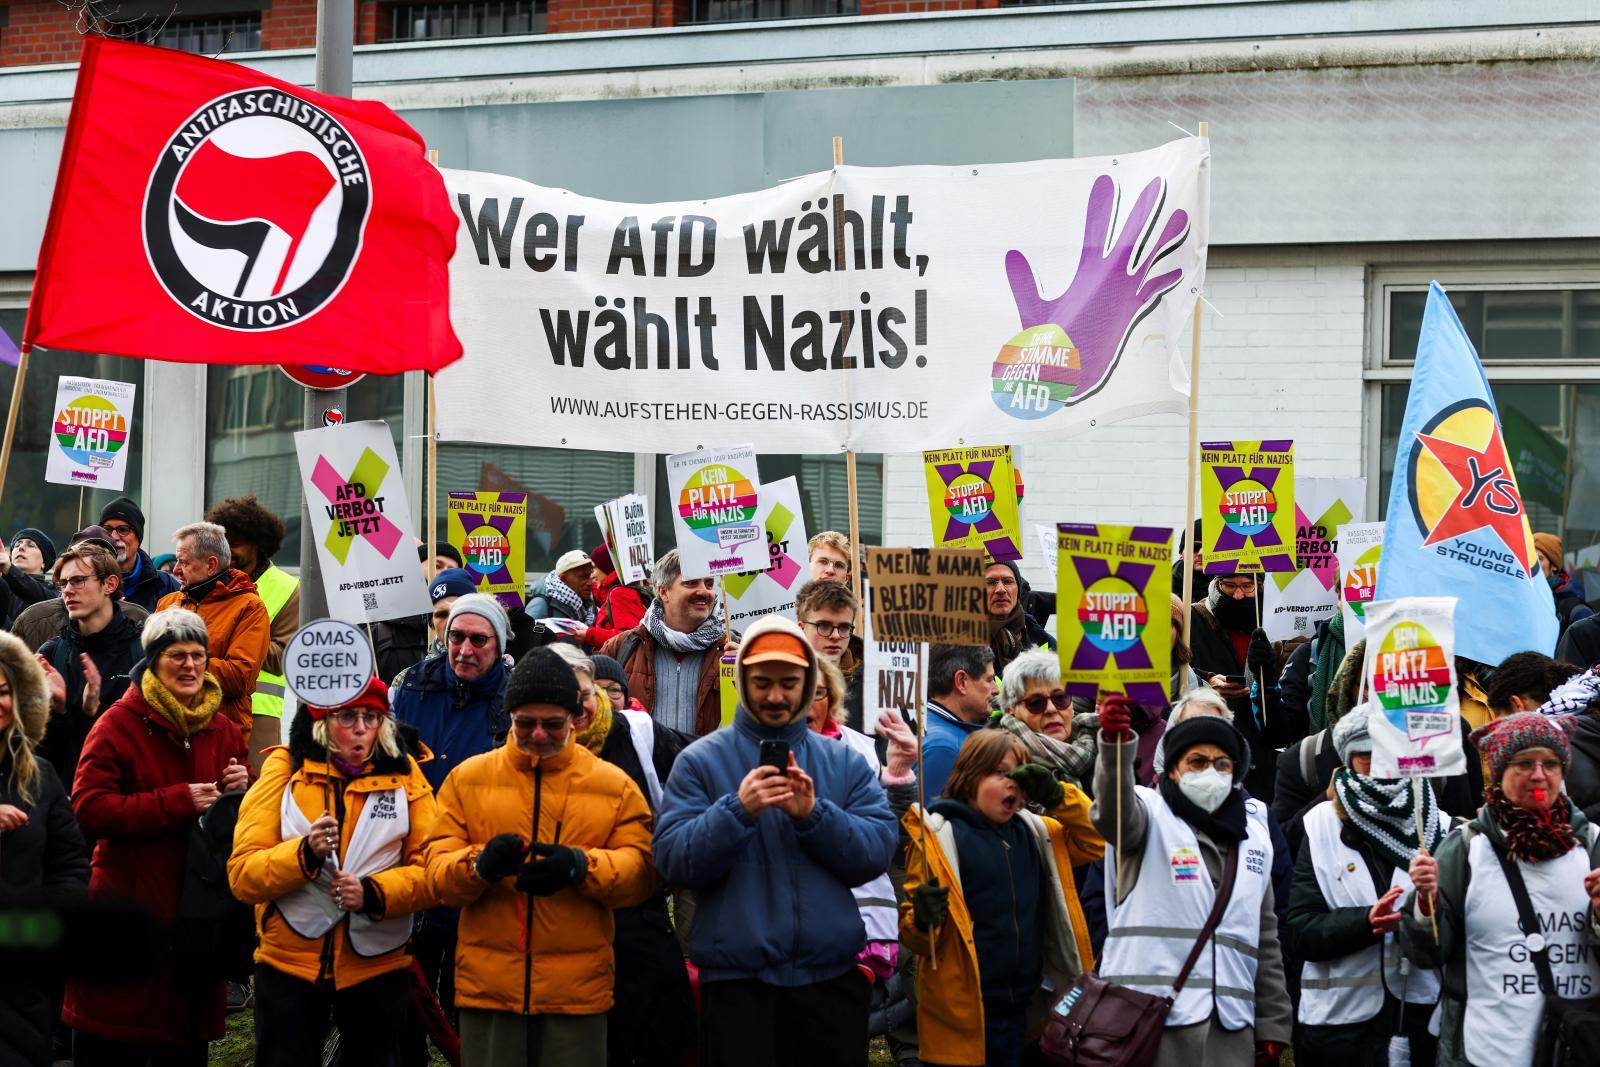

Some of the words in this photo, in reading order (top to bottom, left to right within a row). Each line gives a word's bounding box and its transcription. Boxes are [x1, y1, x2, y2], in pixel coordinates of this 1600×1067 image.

[171, 92, 364, 187] ANTIFASCHISTISCHE
[458, 193, 585, 273] Wer
[605, 214, 717, 278] AfD
[743, 193, 930, 278] wählt,
[191, 291, 299, 326] AKTION
[539, 295, 719, 372] wählt
[743, 289, 928, 372] Nazis!
[1017, 346, 1070, 367] STIMME
[1002, 364, 1040, 383] GEGEN
[1010, 382, 1050, 412] AFD
[61, 407, 120, 430] STOPPT
[550, 396, 929, 422] WWW.AUFSTEHEN-GEGEN-RASSISMUS.DE
[66, 425, 75, 433] DIE
[73, 427, 109, 453] AFD
[924, 454, 941, 464] KEIN
[943, 452, 963, 462] PLATZ
[965, 449, 979, 460] FÜR
[981, 447, 1005, 458] NAZIS!
[1202, 453, 1220, 463] KEIN
[1222, 453, 1246, 464] PLATZ
[1249, 452, 1263, 464] FÜR
[1267, 455, 1293, 465] NAZIS!
[701, 467, 728, 486] KEIN
[1459, 456, 1520, 516] YS
[336, 482, 366, 501] AFD
[688, 483, 737, 510] PLATZ
[949, 481, 986, 500] STOPPT
[1225, 489, 1268, 506] STOPPT
[325, 497, 385, 521] VERBOT
[449, 500, 465, 511] KEIN
[466, 502, 487, 512] PLATZ
[488, 503, 501, 513] FÜR
[503, 505, 526, 515] NAZIS!
[624, 502, 644, 520] BJÖRN
[692, 508, 709, 521] FÜR
[709, 505, 746, 525] NAZIS
[962, 495, 988, 517] AFD
[1240, 505, 1268, 527] AFD
[337, 517, 380, 538] JETZT
[626, 520, 646, 538] HÖCKE
[1296, 525, 1328, 539] AFD
[468, 535, 503, 548] STOPPT
[1058, 536, 1080, 552] KEIN
[1084, 540, 1113, 556] PLATZ
[1116, 541, 1136, 557] FÜR
[1139, 546, 1172, 561] NAZIS!
[1455, 538, 1514, 564] YOUNG
[478, 548, 502, 566] AFD
[876, 553, 931, 576] MEINE
[936, 554, 982, 577] MAMA
[1296, 555, 1331, 568] ETZT
[1437, 545, 1525, 580] STRUGGLE
[339, 576, 404, 592] AFD-VERBOT.JETZT
[1360, 588, 1371, 598] DIE
[879, 582, 938, 613] BLEIBT
[1085, 592, 1138, 611] STOPPT
[1274, 604, 1333, 614] AFD-VERBOT.JETZT
[1101, 613, 1137, 641] AFD
[301, 630, 355, 646] OMAS
[297, 652, 357, 668] GEGEN
[892, 656, 901, 667] IST
[902, 656, 910, 667] EIN
[1382, 650, 1429, 682] PLATZ
[295, 673, 362, 690] RECHTS
[1385, 680, 1400, 698] FÜR
[1400, 681, 1439, 706] NAZIS
[1517, 911, 1586, 932] MAS
[1508, 943, 1589, 964] GGEN
